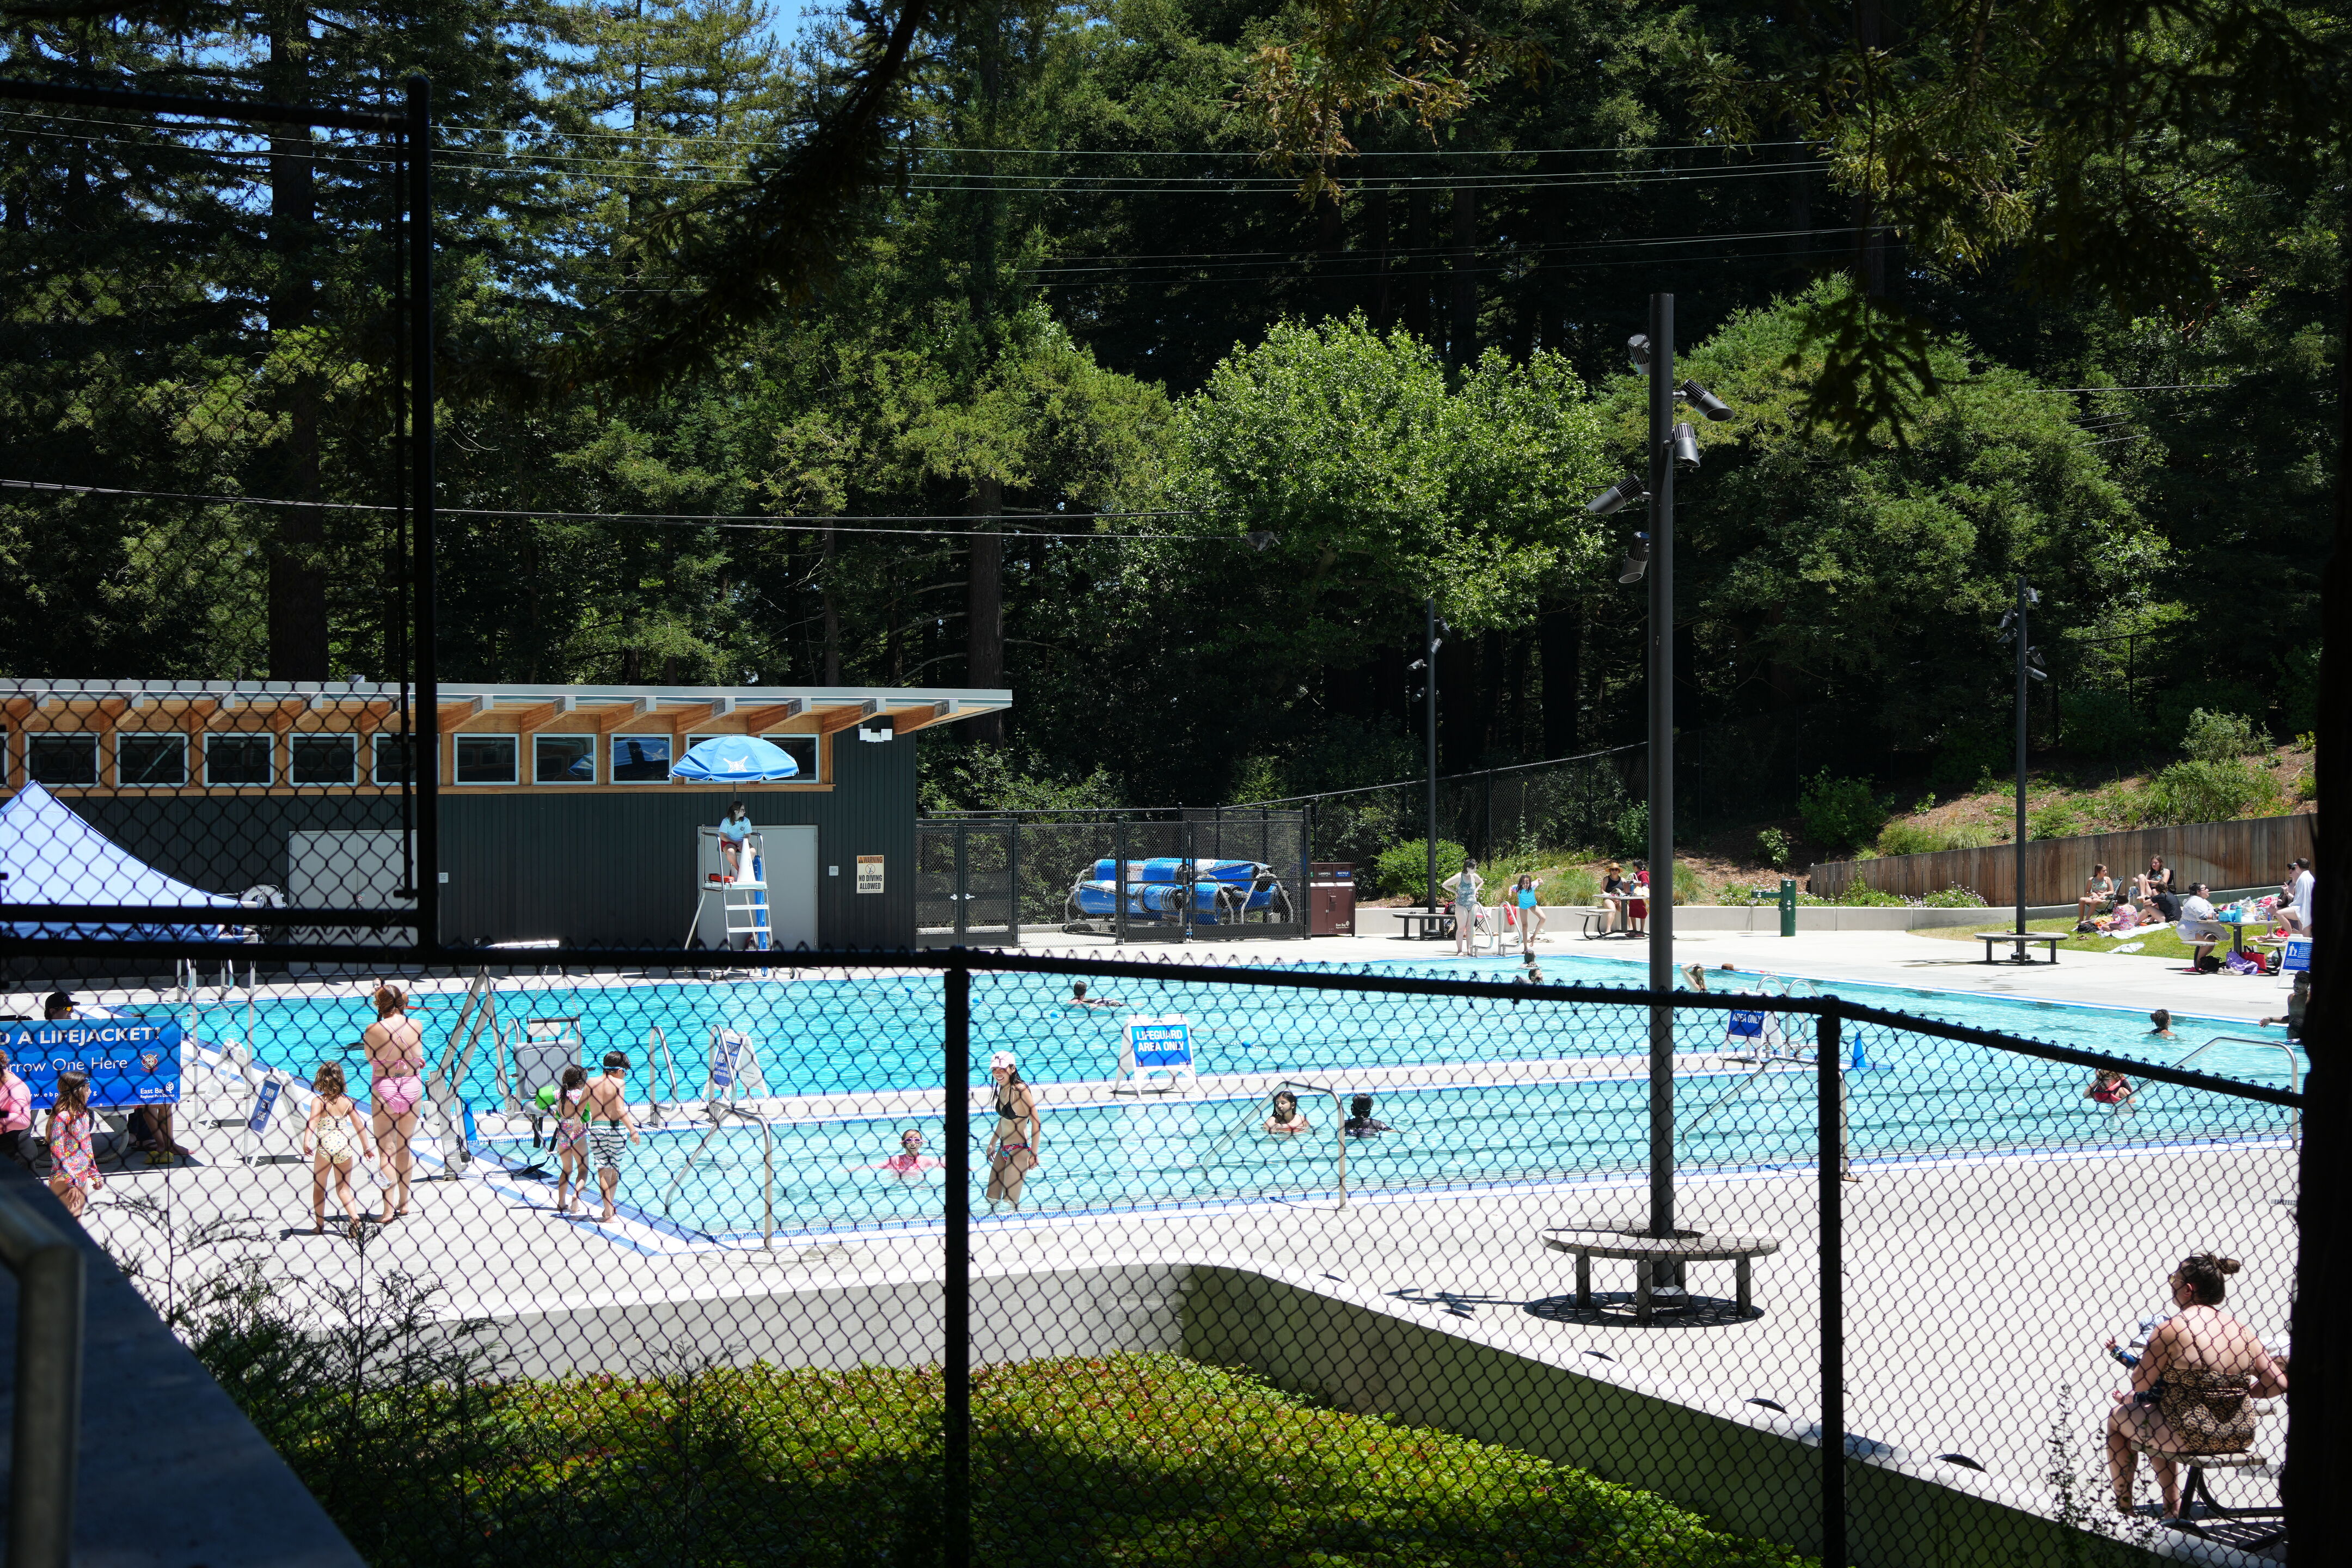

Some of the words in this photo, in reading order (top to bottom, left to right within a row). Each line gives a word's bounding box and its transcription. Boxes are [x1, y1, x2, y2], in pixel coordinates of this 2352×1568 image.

[1732, 1013, 1747, 1022] AREA
[1748, 1014, 1762, 1024] ONLY
[17, 1031, 33, 1045] A
[40, 1027, 161, 1046] LIFEJACKET?
[1136, 1030, 1183, 1040] LIFEGUARD
[1138, 1042, 1162, 1052] AREA
[1163, 1041, 1184, 1051] ONLY
[6, 1063, 46, 1073] rrow
[53, 1058, 84, 1071] One
[91, 1057, 127, 1070] Here
[265, 1087, 275, 1099] SWIM
